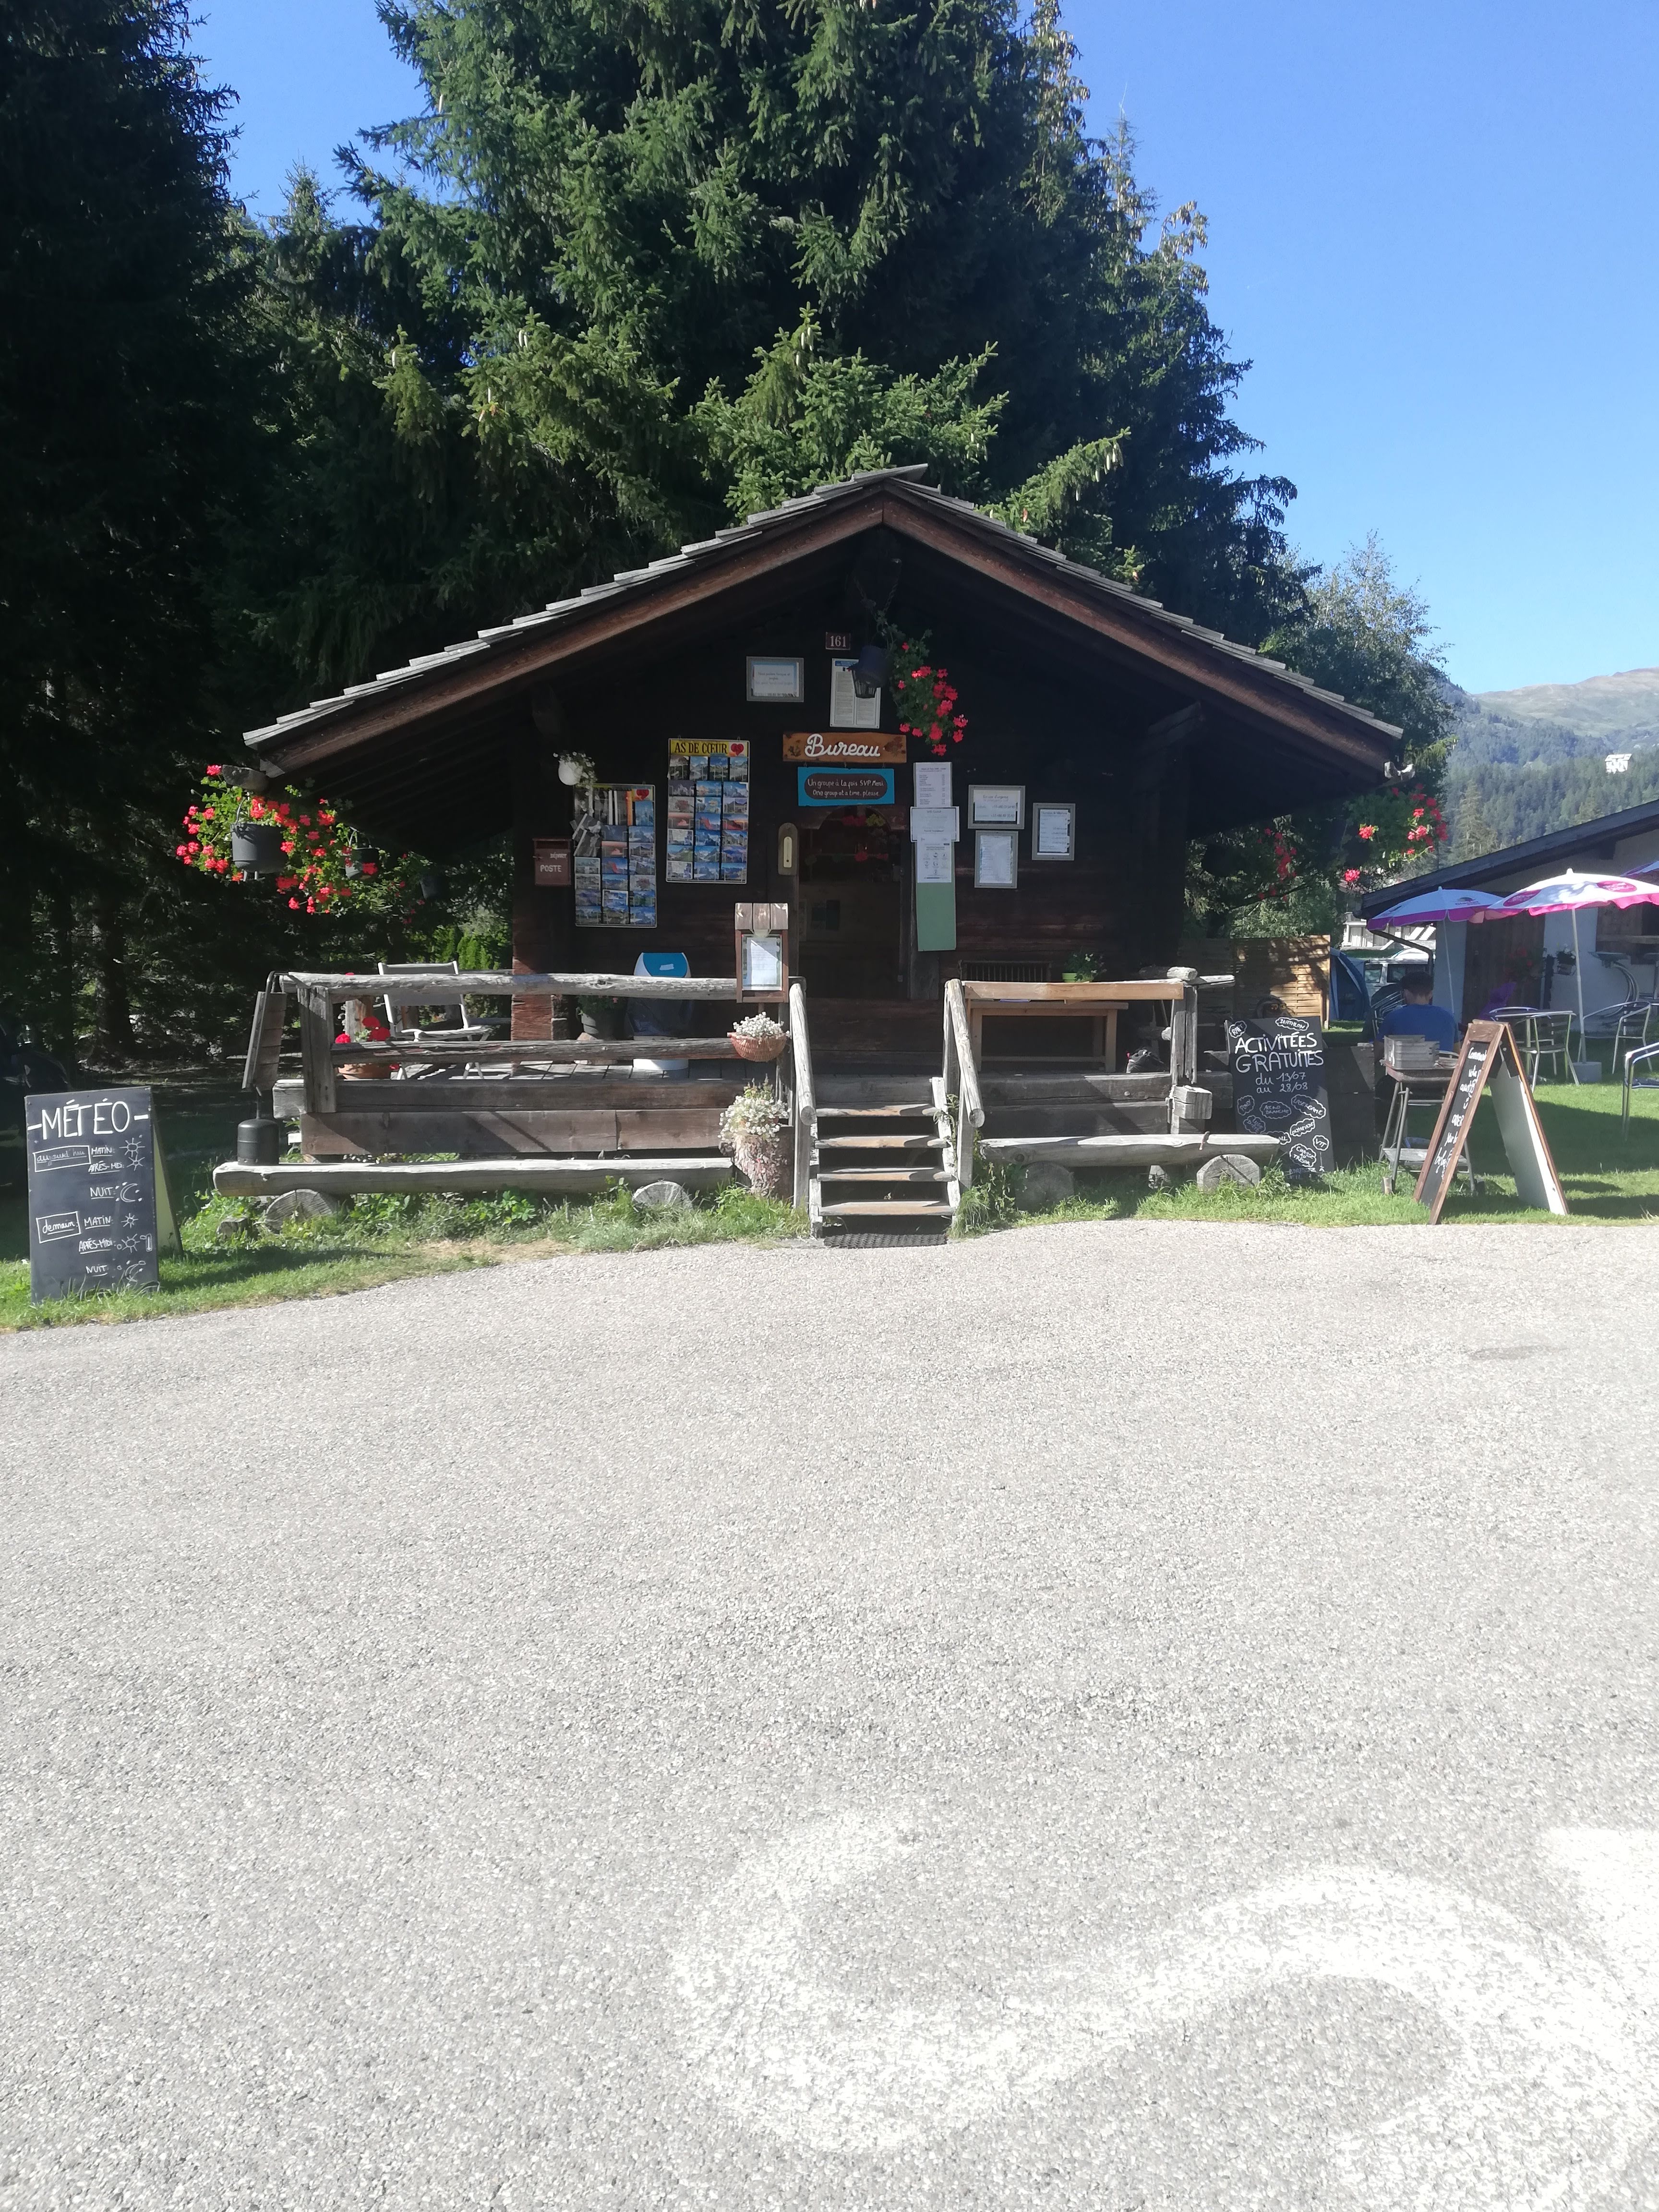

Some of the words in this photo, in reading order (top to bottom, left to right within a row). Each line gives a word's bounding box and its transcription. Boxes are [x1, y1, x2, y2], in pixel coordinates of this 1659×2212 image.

[830, 635, 846, 647] 161
[674, 742, 686, 753] AS
[689, 743, 699, 754] DE
[805, 733, 881, 757] Bureau
[817, 781, 834, 789] groupe
[847, 781, 858, 790] fois
[1236, 1049, 1324, 1073] GRATUITES
[1255, 1073, 1274, 1085] du
[1276, 1071, 1306, 1082] 13/07
[1279, 1082, 1308, 1093] 28/08
[41, 1098, 130, 1140] MÉTÉO
[1316, 1138, 1327, 1147] VTT
